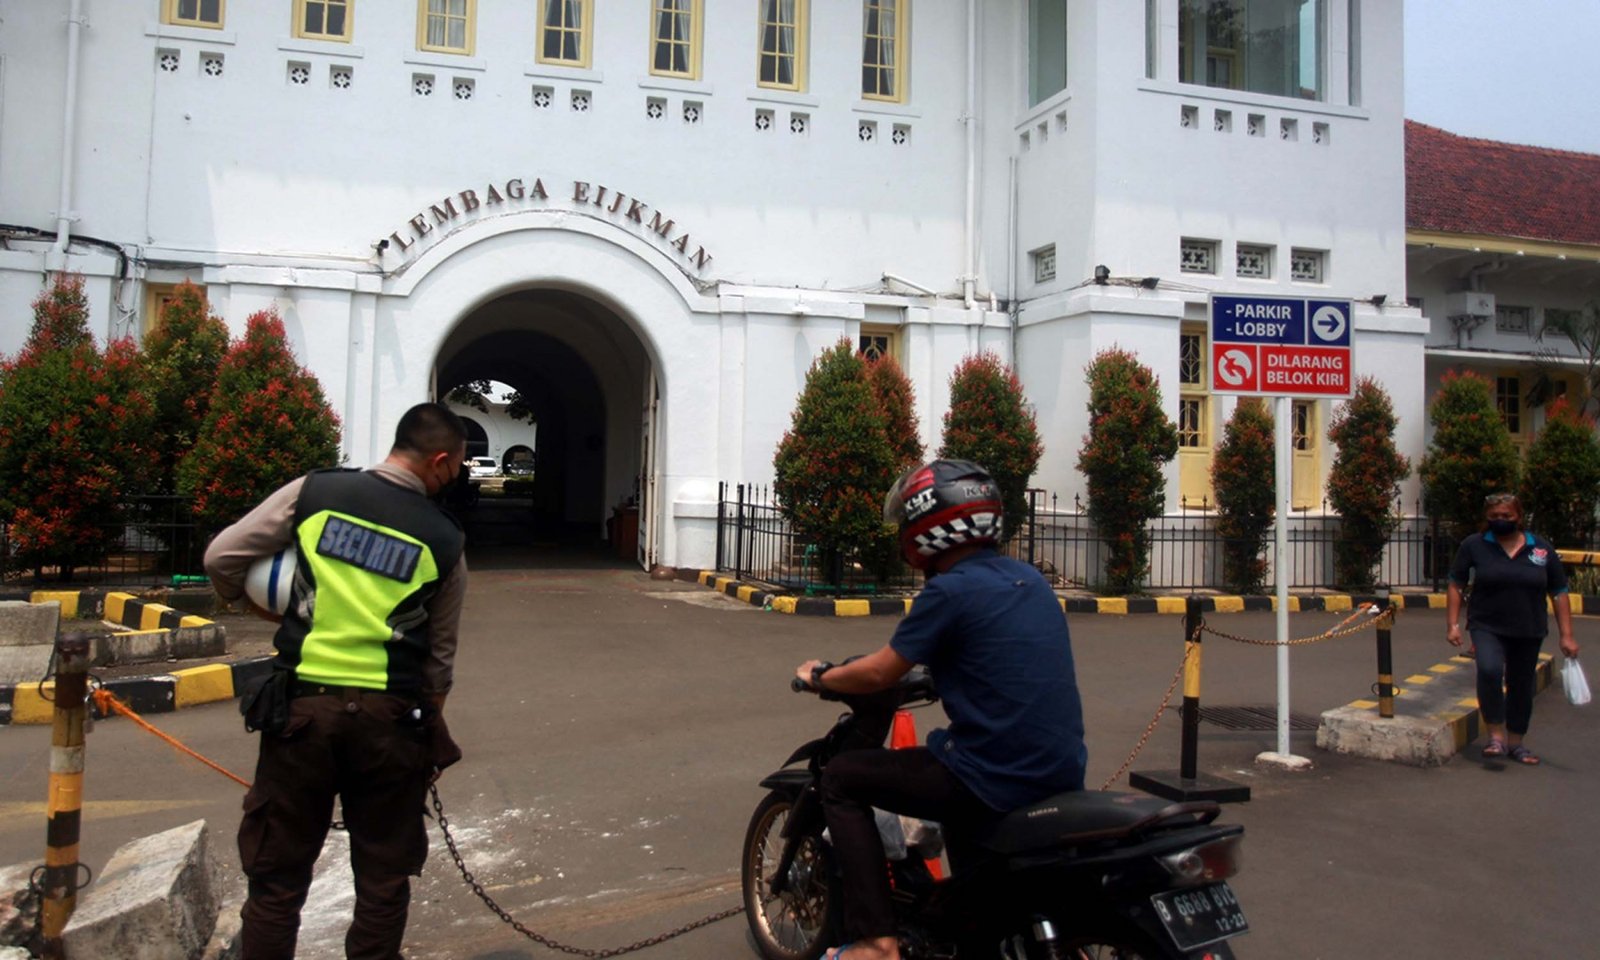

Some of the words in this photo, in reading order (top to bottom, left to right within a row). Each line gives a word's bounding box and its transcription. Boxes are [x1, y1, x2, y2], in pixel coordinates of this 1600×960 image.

[389, 177, 549, 251] LEMBAGA
[571, 181, 713, 270] EIJKMAN
[1268, 354, 1342, 369] DILARANG
[1267, 371, 1313, 385] BELOK
[1316, 373, 1343, 386] KIRI
[1156, 900, 1171, 921] B
